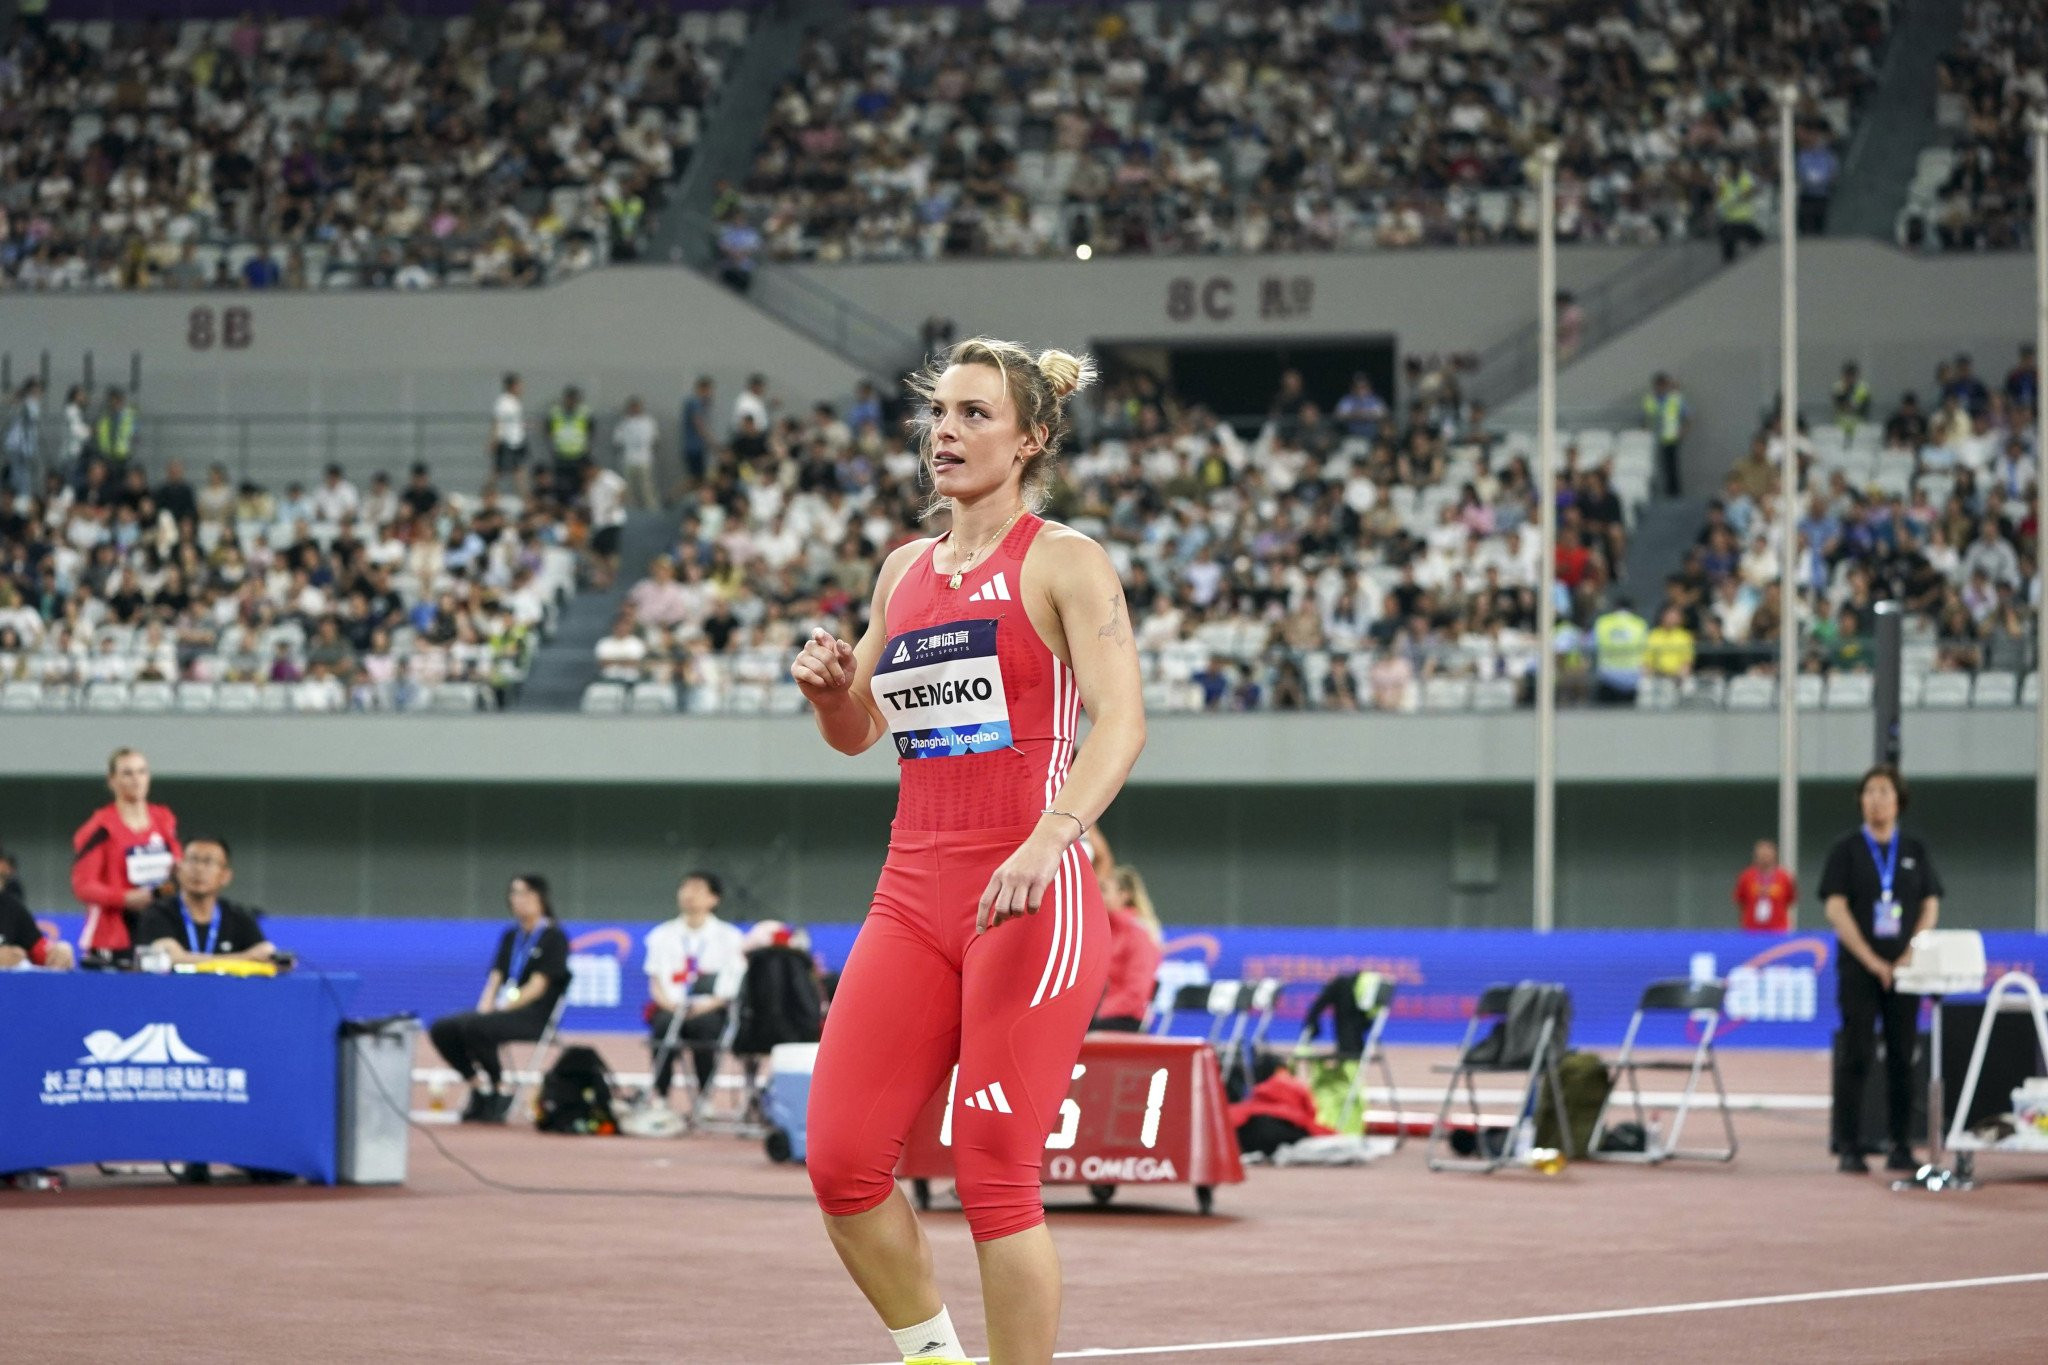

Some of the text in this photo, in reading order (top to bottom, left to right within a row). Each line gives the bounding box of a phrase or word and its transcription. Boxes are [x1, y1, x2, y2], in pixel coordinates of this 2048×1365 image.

[1166, 275, 1235, 323] 8C
[187, 304, 253, 352] 8B
[915, 630, 970, 653] 久事体育
[915, 645, 970, 660] JUSS SPORTS
[883, 677, 992, 711] TZENGKO
[910, 731, 1000, 749] Shanghai Keqiao
[1081, 1156, 1178, 1181] OMEGA
